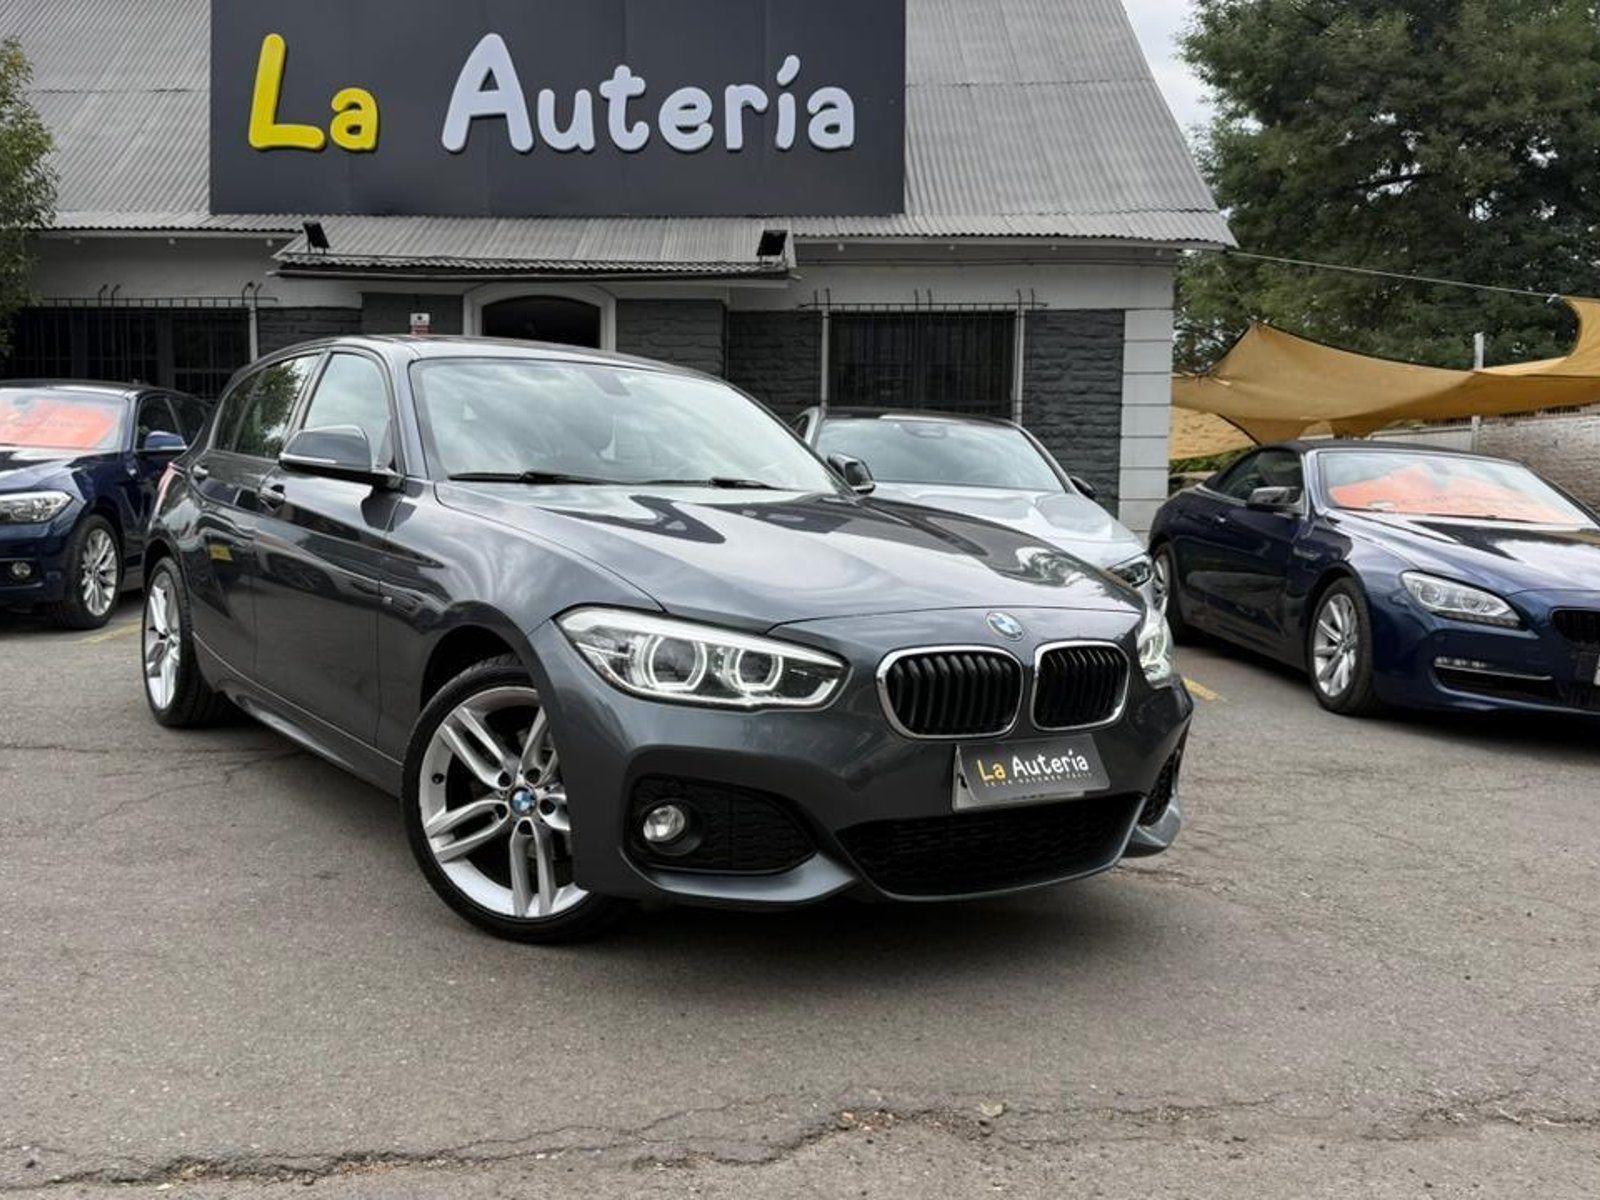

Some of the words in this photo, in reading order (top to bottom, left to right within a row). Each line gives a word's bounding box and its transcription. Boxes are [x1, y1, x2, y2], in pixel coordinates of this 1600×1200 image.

[249, 33, 379, 150] La
[442, 33, 854, 151] Autería
[977, 759, 1006, 781] La
